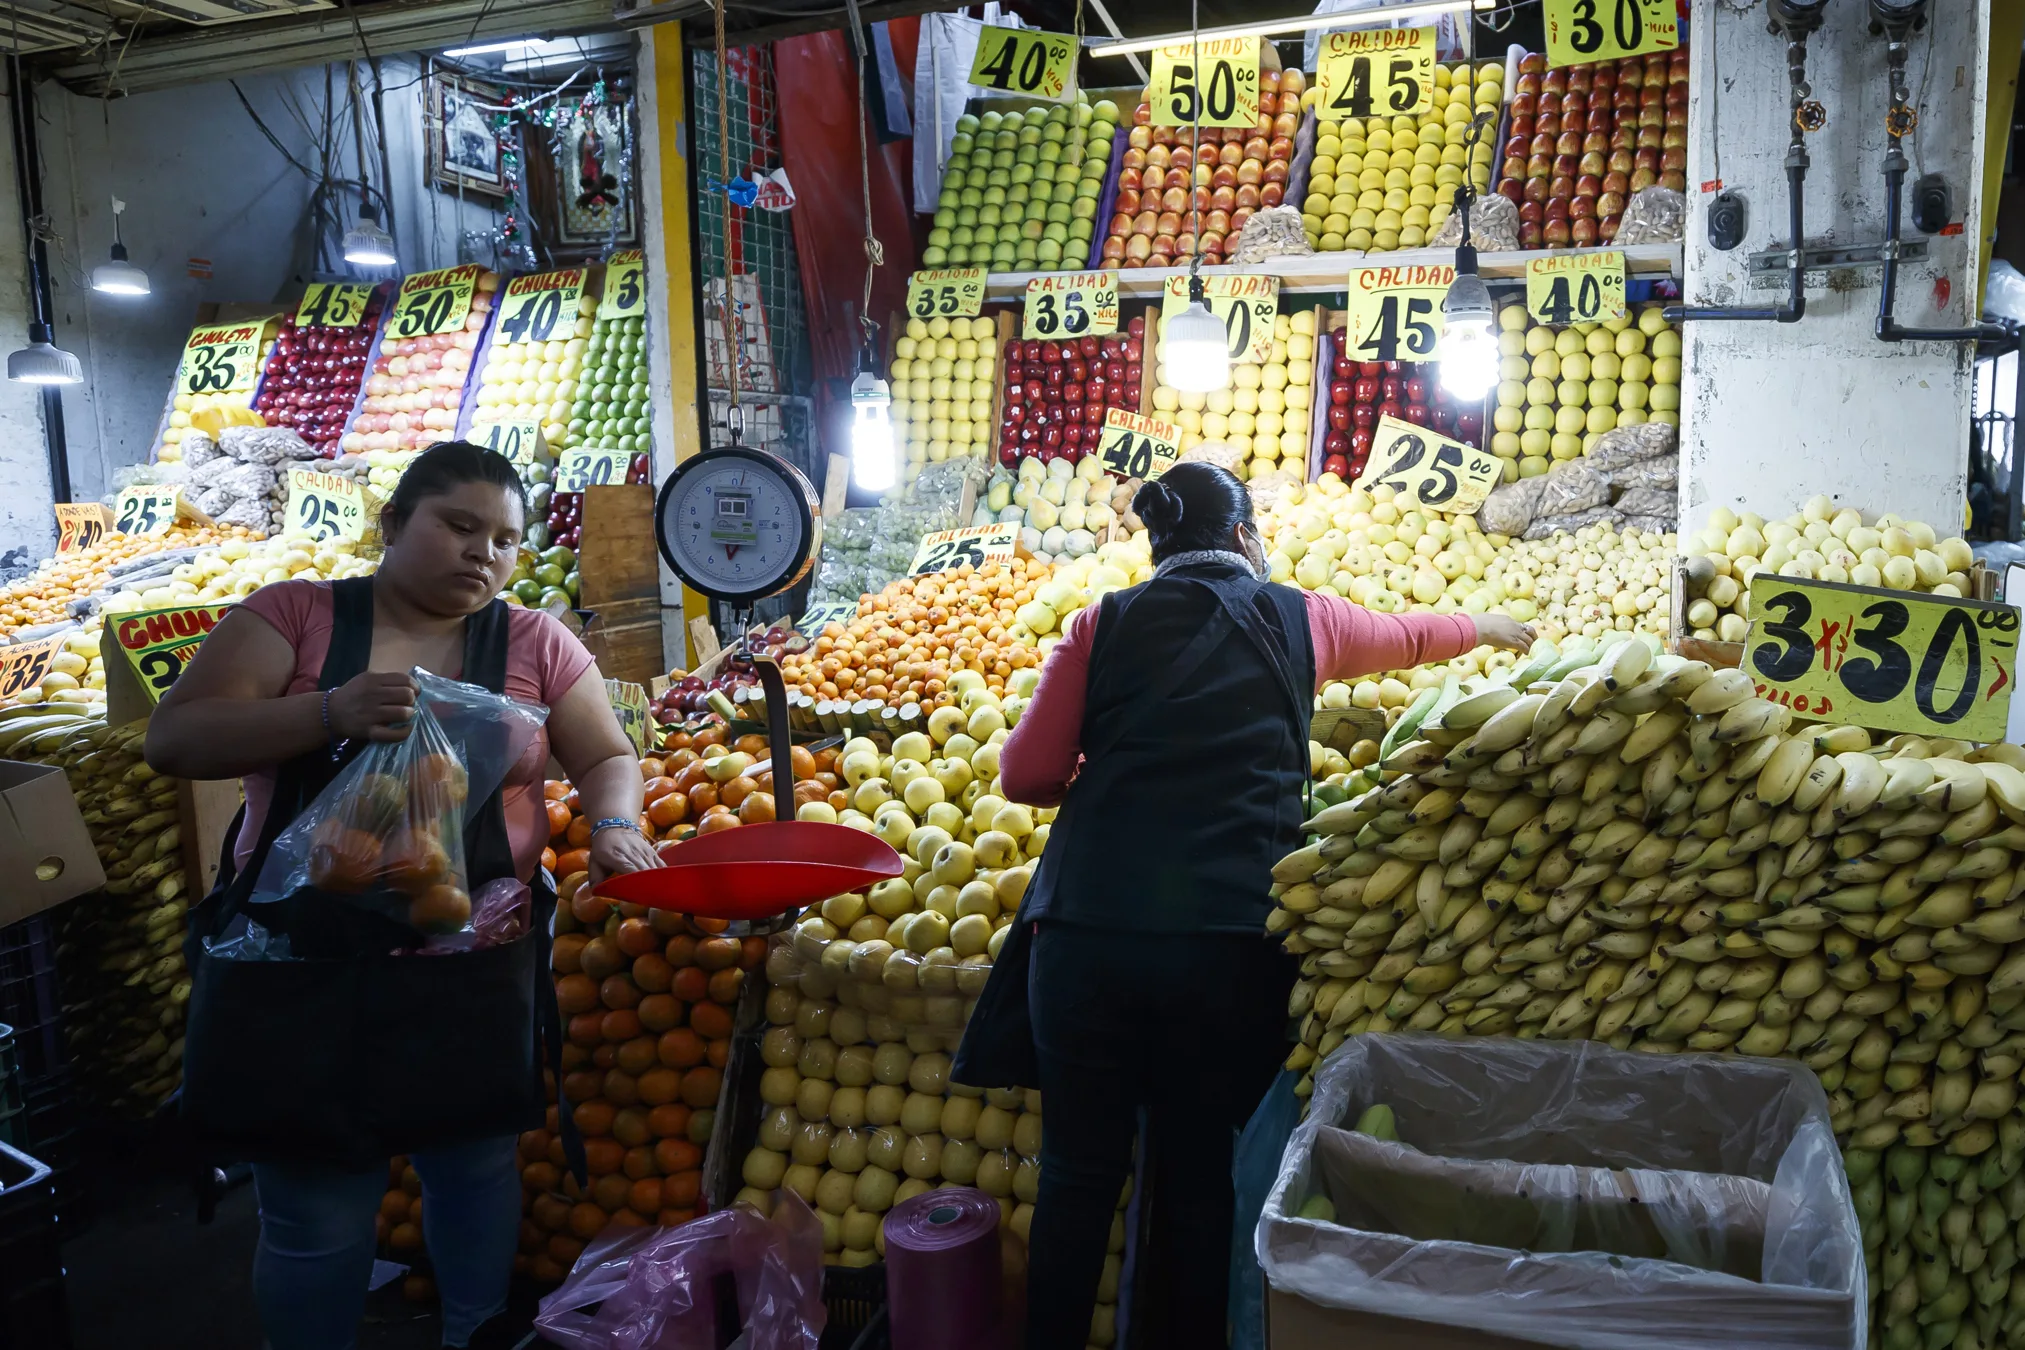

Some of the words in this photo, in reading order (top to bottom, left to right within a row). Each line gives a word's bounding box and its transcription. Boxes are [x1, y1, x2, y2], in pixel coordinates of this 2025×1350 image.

[1330, 28, 1420, 52] CALIDAD
[1570, 0, 1643, 53] 30
[1649, 22, 1675, 33] KILO
[979, 35, 1047, 91] 40
[1163, 37, 1243, 57] CAIDAD
[1169, 60, 1236, 122] 50
[1329, 57, 1420, 118] 45
[916, 267, 980, 283] CALIDAD
[1359, 265, 1454, 290] CALIDAD
[1532, 252, 1615, 273] CALIDAD
[1026, 271, 1109, 293] CALIDAD
[1171, 275, 1272, 297] CLIDAD
[1538, 273, 1601, 324] 40
[300, 284, 350, 327] 45
[398, 289, 455, 336] 50
[501, 290, 562, 344] 40
[915, 287, 960, 316] 35
[1035, 292, 1090, 334] 35
[1357, 296, 1437, 361] 45
[188, 345, 237, 392] 35
[1102, 430, 1153, 479] 40
[1363, 433, 1464, 506] 25
[295, 471, 354, 496] CALIDAD
[567, 455, 613, 491] 30
[705, 486, 712, 495] 9
[757, 485, 762, 495] 1
[116, 497, 157, 536] 25
[300, 493, 341, 543] 25
[690, 506, 697, 516] 8
[774, 506, 781, 516] 2
[691, 534, 698, 544] 7
[775, 533, 782, 543] 3
[915, 537, 986, 575] 25
[707, 555, 715, 565] 6
[734, 563, 741, 573] 5
[759, 555, 767, 564] 4
[118, 607, 229, 650] CHUL
[2, 650, 51, 697] 35
[1751, 590, 1817, 683] 3
[1838, 600, 1983, 725] 30
